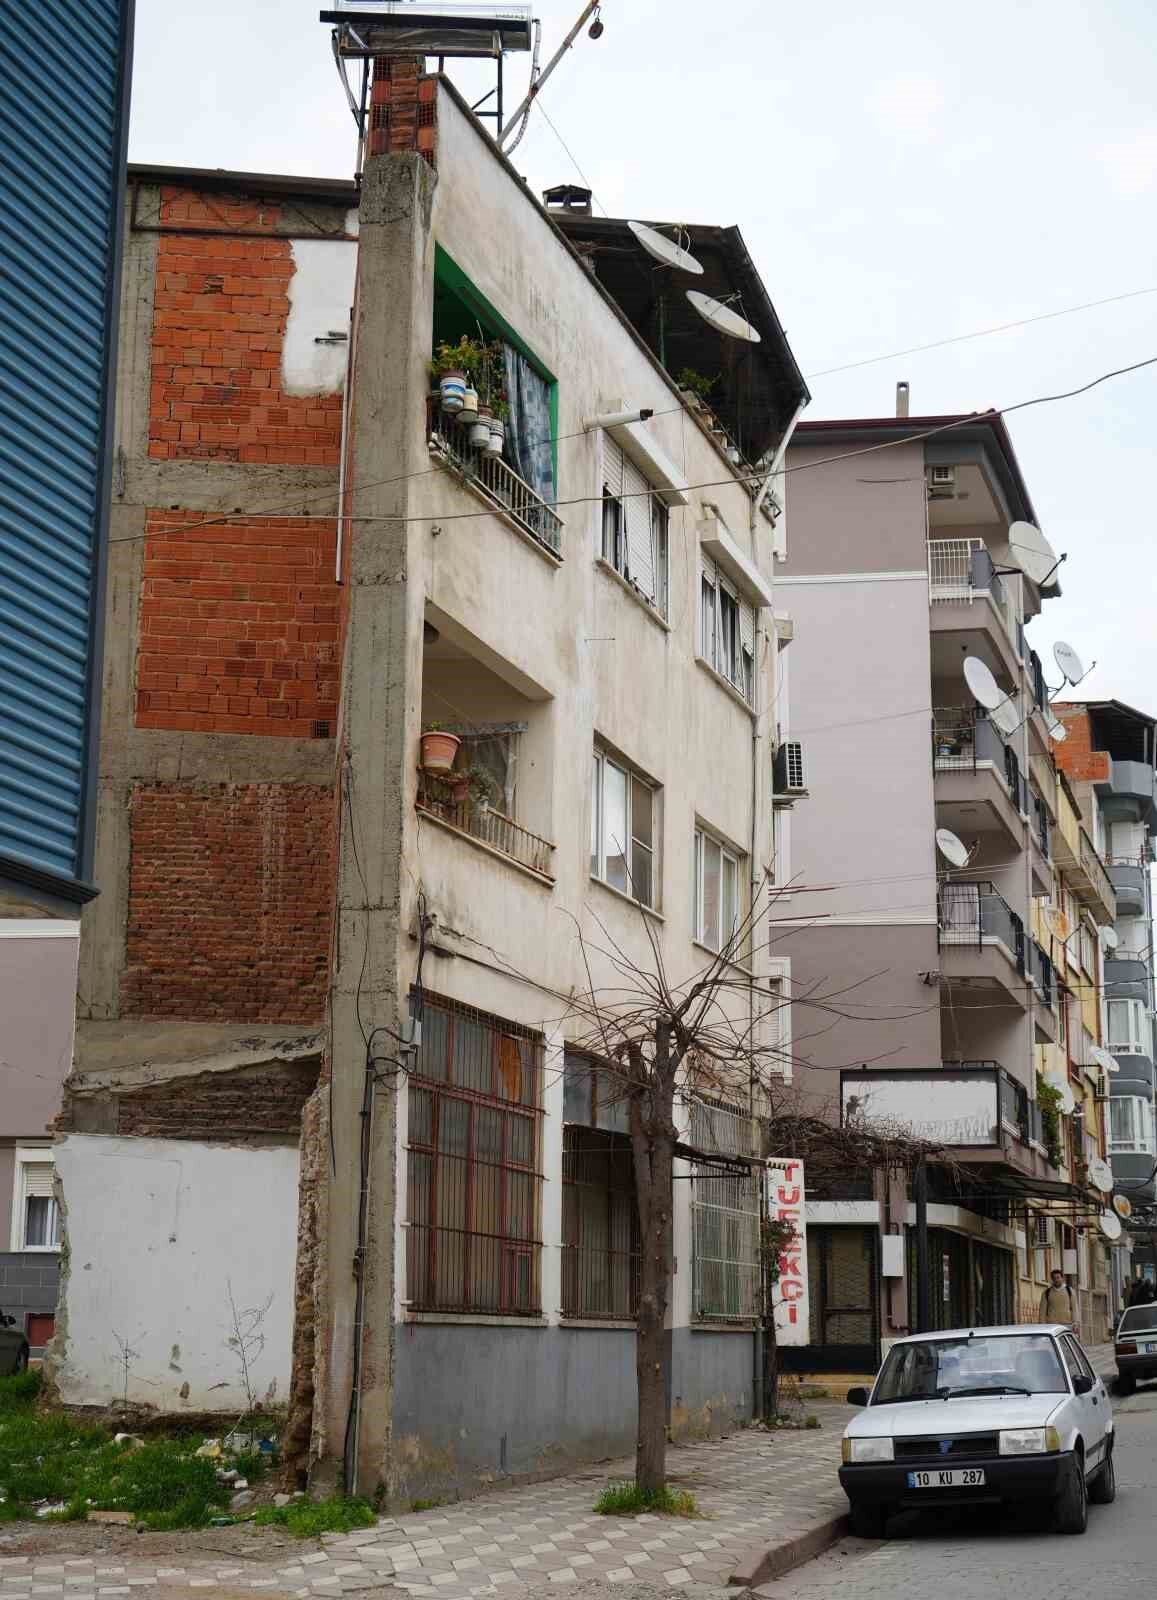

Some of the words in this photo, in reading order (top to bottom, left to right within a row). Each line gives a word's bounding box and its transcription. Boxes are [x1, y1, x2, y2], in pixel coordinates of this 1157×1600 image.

[916, 1472, 929, 1486] 10
[938, 1471, 953, 1485] KU
[962, 1470, 983, 1484] 287
